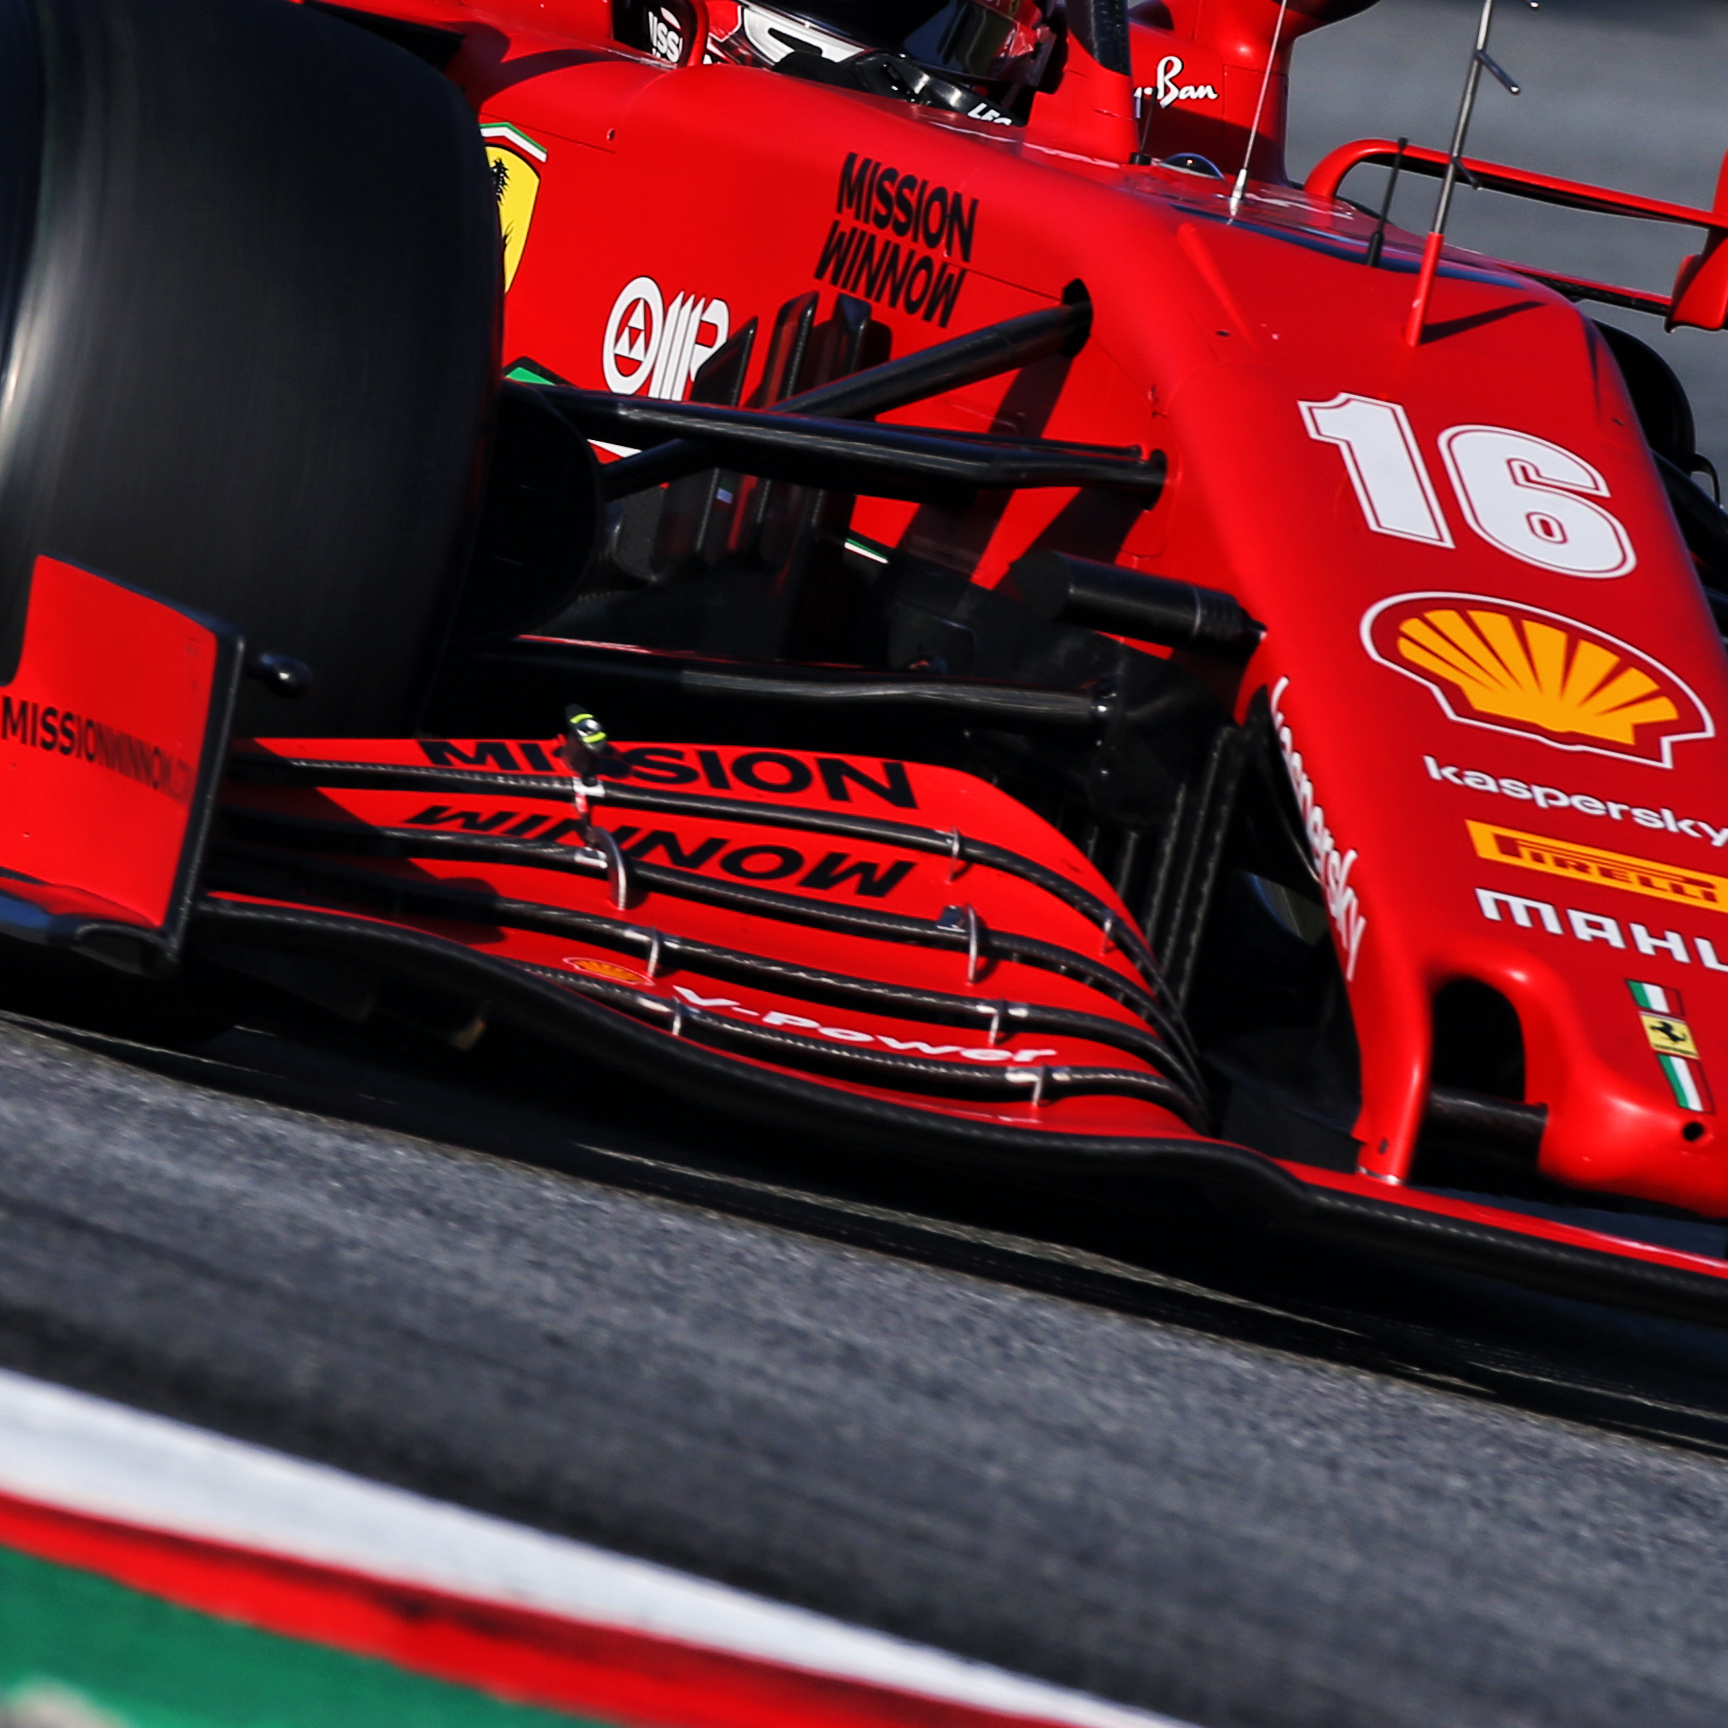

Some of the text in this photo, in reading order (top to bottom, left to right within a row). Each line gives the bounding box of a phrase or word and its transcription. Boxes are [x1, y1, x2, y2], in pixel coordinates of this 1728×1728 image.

[835, 151, 979, 263] MISSION
[814, 220, 967, 329] WINNOW
[1298, 391, 1637, 578] 16
[1493, 832, 1718, 904] PIRELLI
[674, 985, 1056, 1064] V-Power
